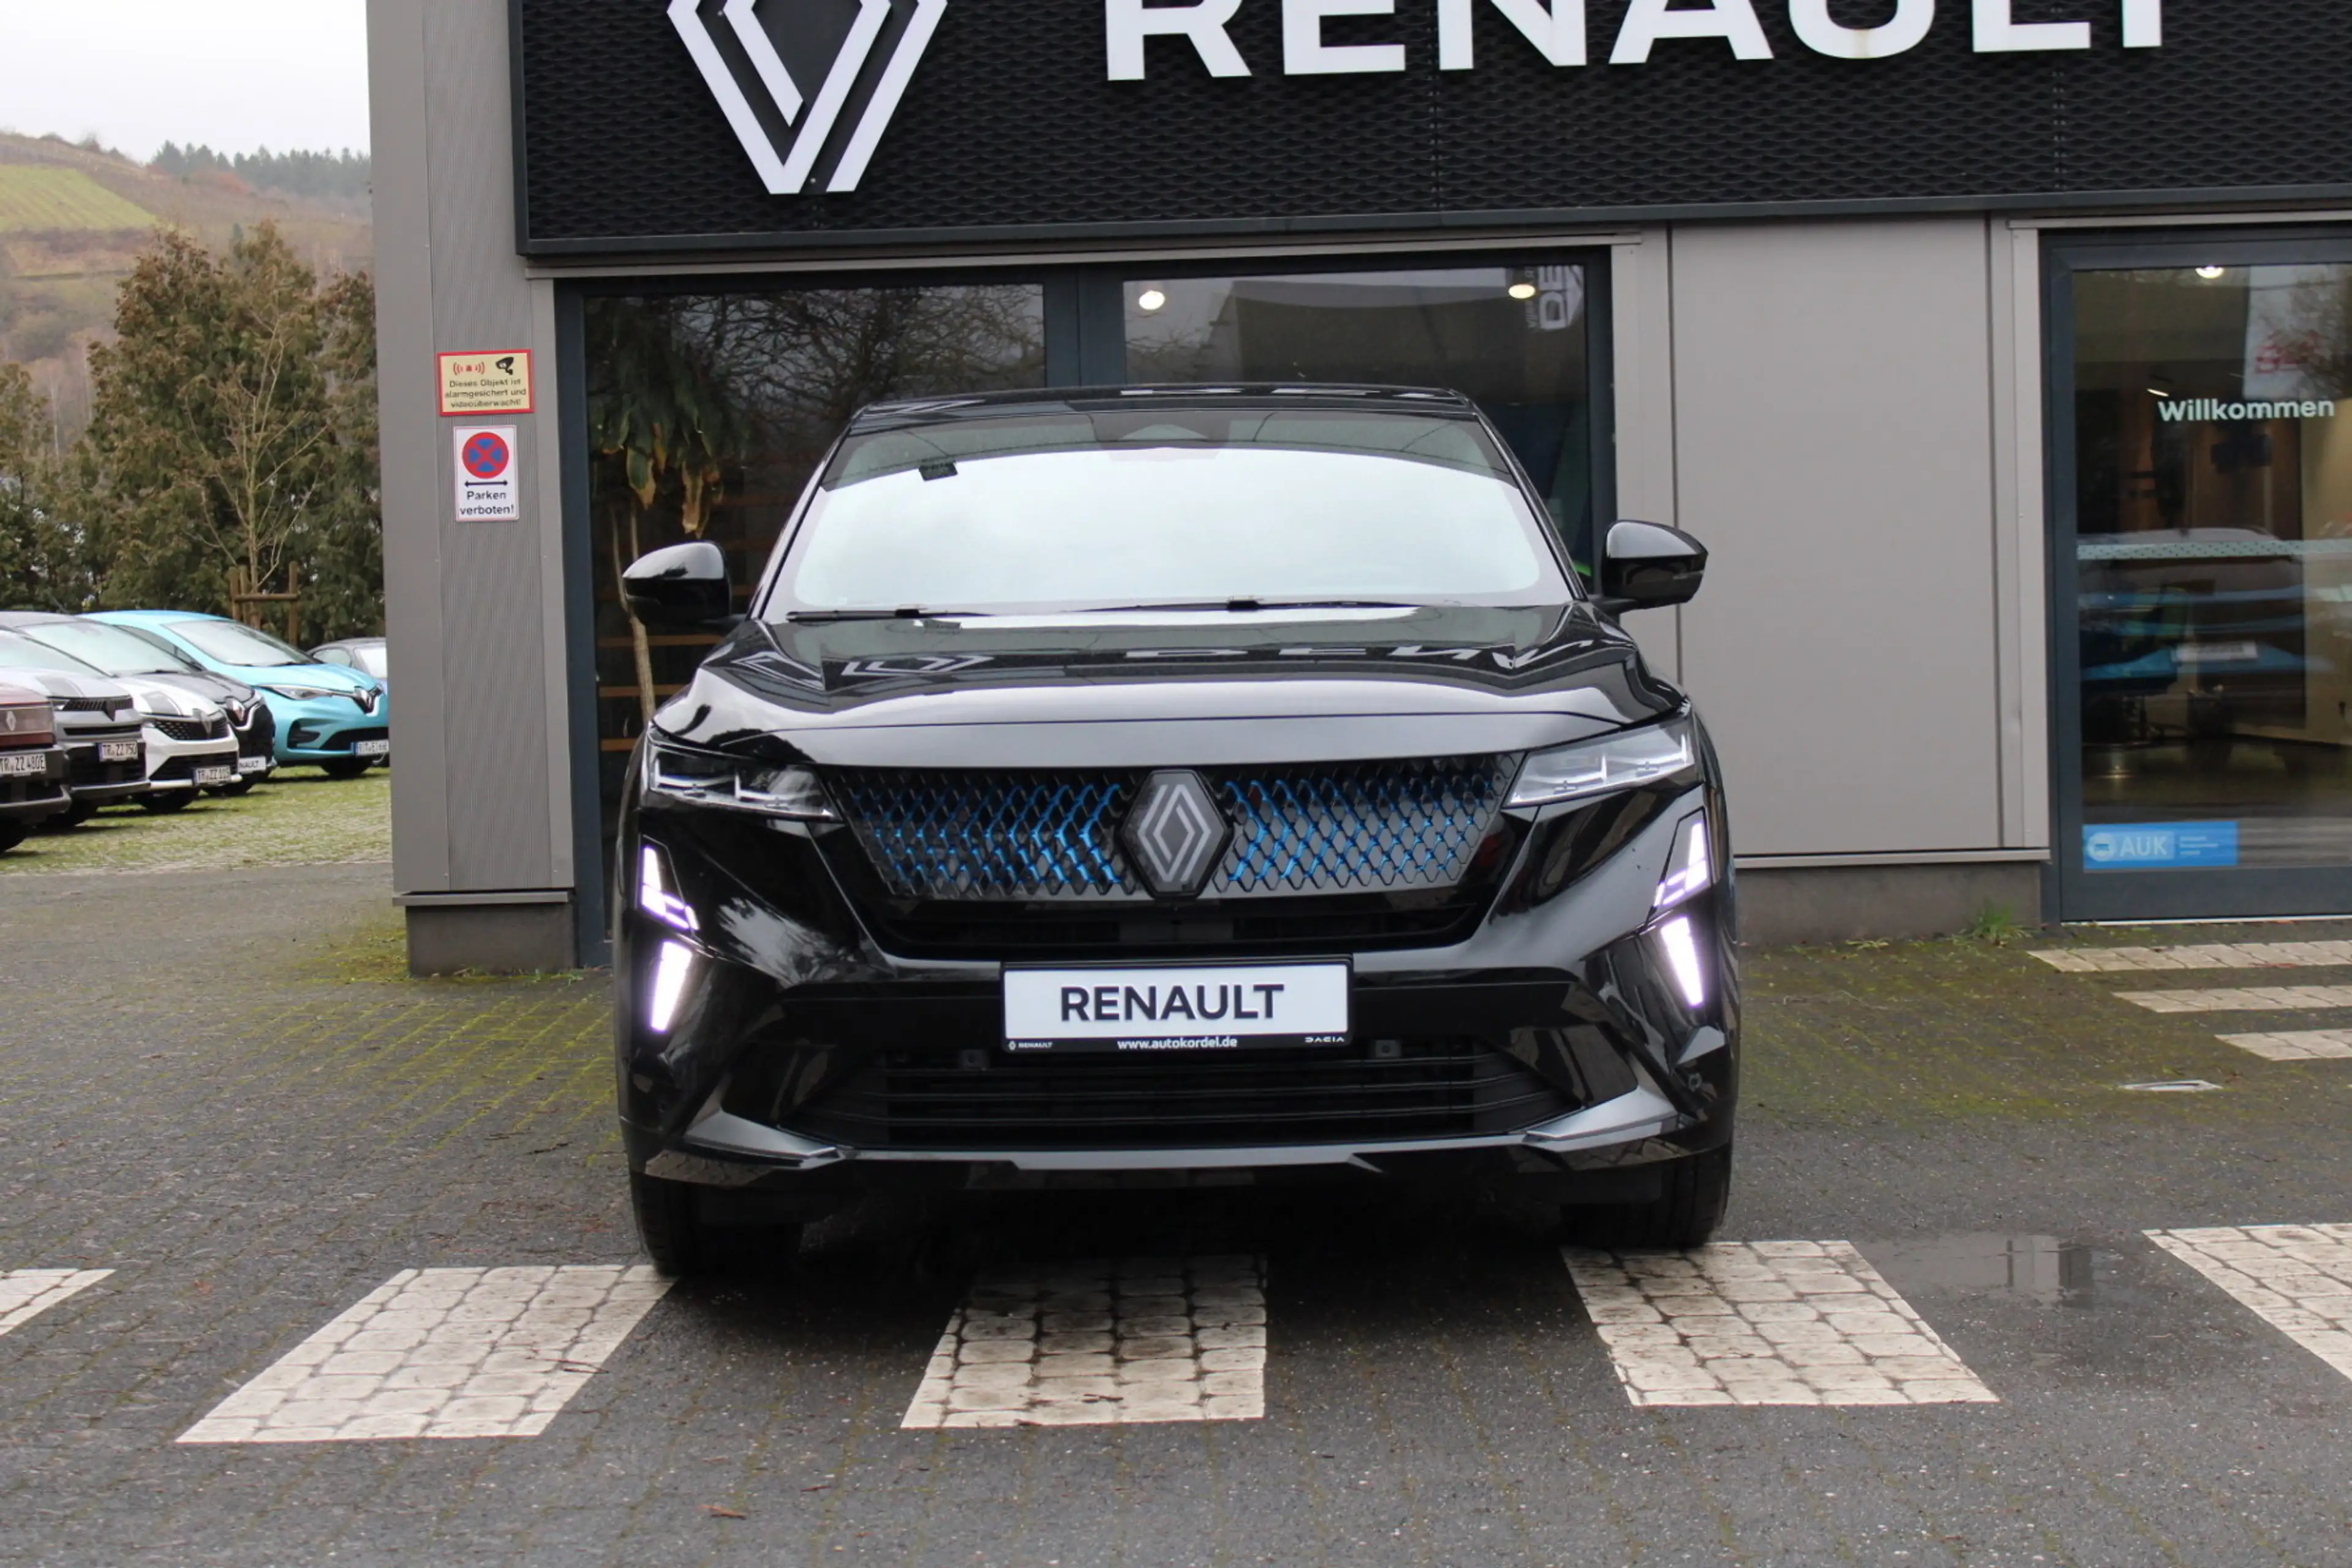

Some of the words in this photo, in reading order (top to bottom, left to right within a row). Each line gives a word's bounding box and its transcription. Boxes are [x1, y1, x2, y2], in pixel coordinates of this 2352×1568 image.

[449, 379, 478, 388] Dieses
[480, 378, 508, 387] Objekt
[445, 389, 508, 399] alarmgesichert
[2157, 398, 2335, 421] Willkommen
[466, 490, 507, 500] Parken
[460, 504, 514, 515] verboten!
[2119, 836, 2168, 856] AUK
[1061, 984, 1285, 1021] RENAULT
[1117, 1036, 1238, 1049] www.autokordel.de
